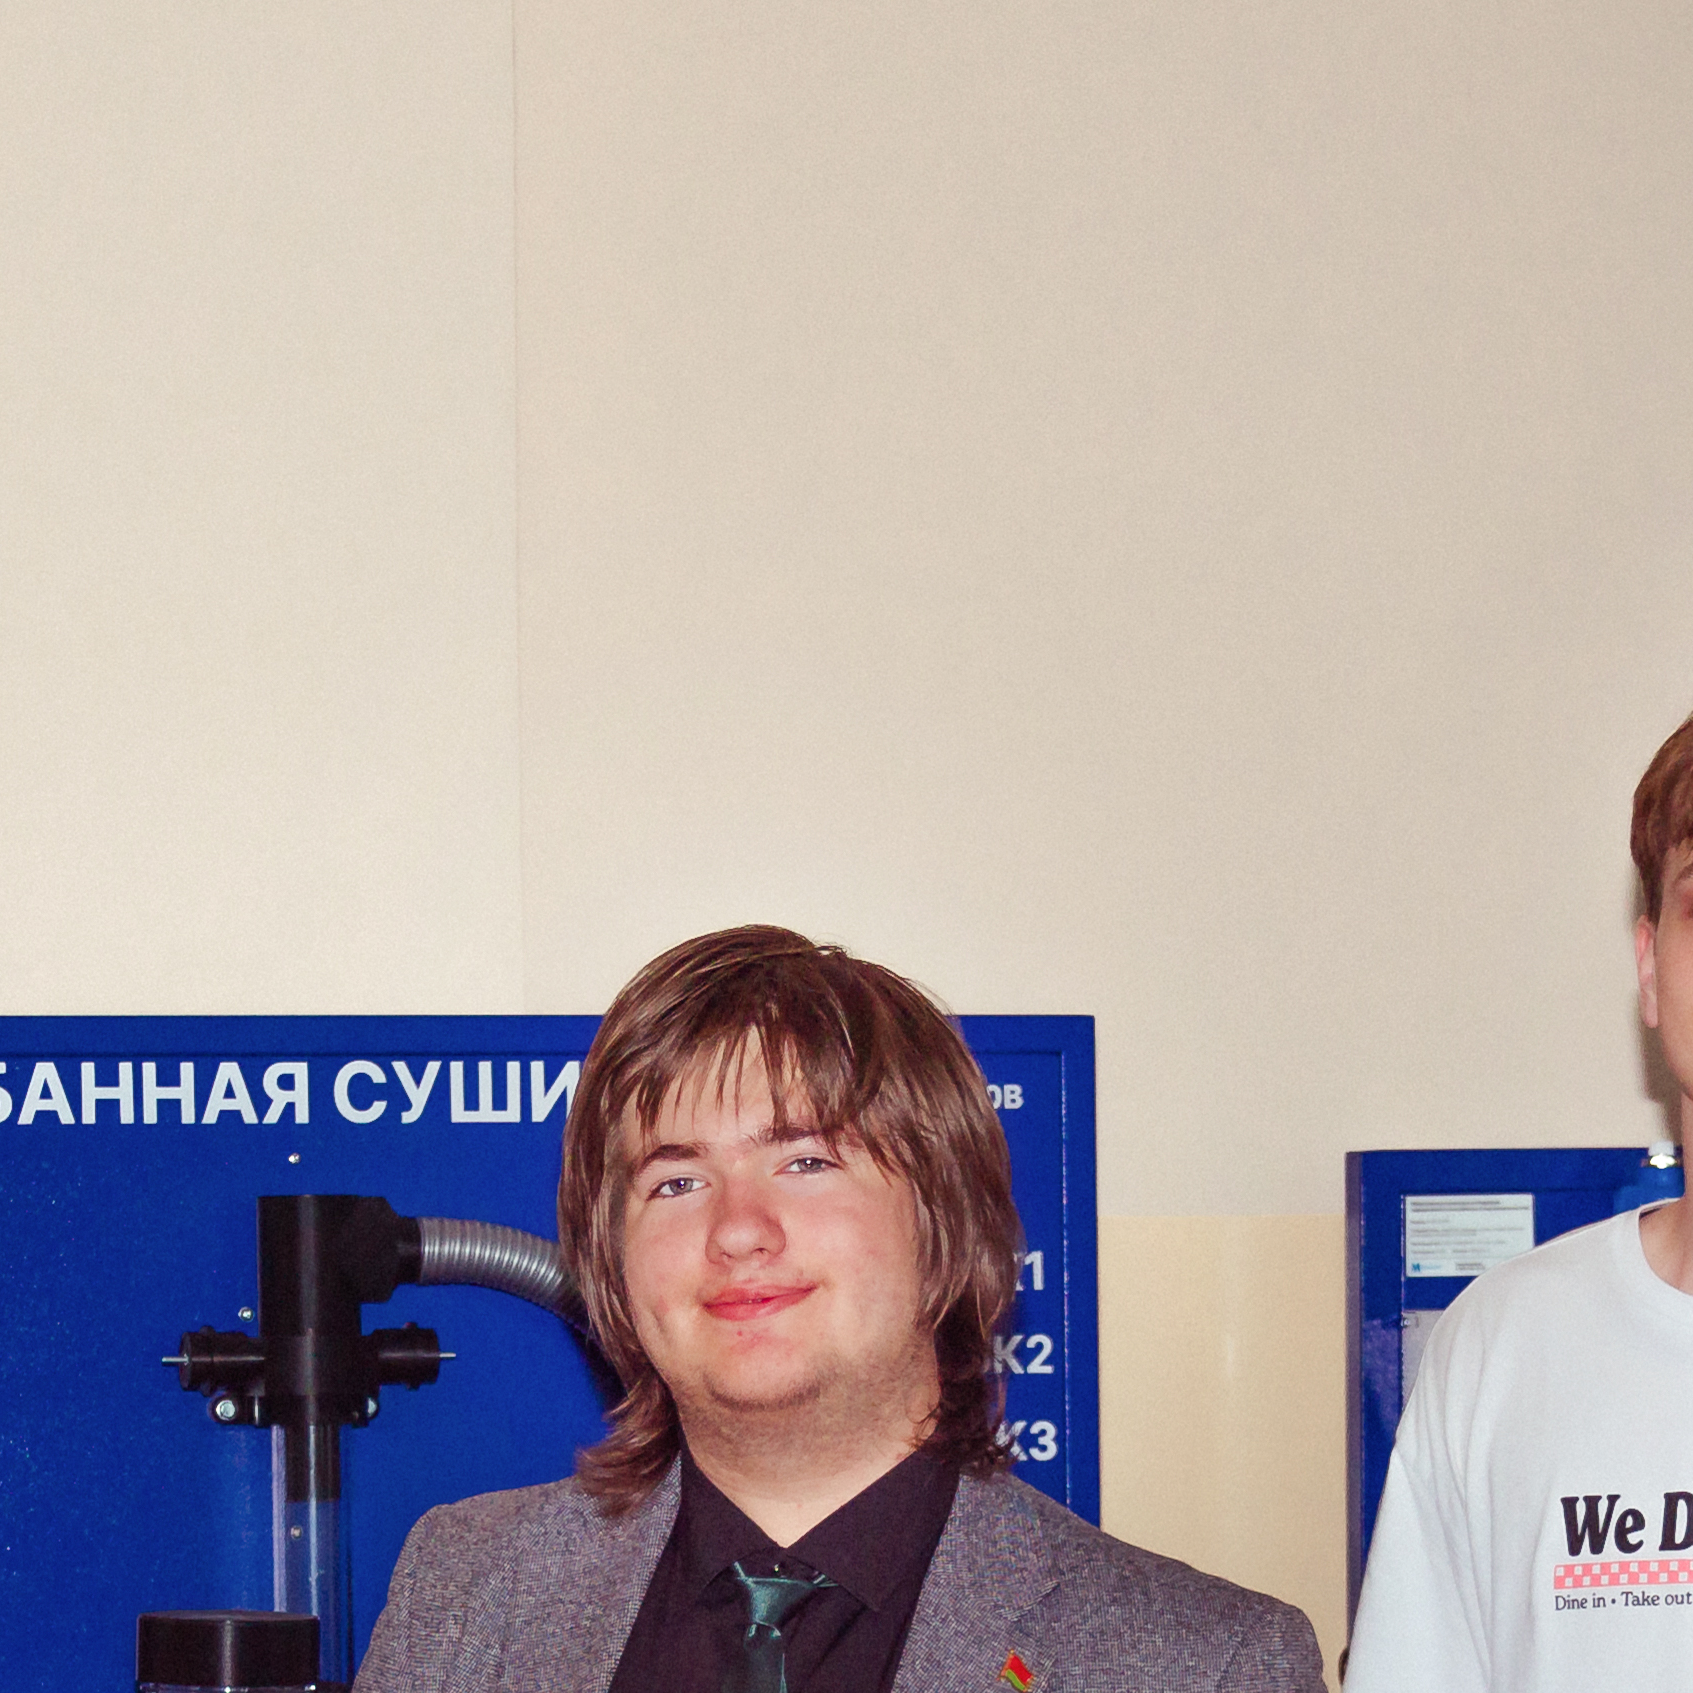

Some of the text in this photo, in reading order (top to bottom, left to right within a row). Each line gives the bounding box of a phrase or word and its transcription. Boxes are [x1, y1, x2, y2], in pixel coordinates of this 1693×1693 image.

[333, 1059, 580, 1123] СУШИ
[1560, 1494, 1646, 1557] We
[1554, 1594, 1588, 1611] Dine
[1592, 1593, 1607, 1608] in
[1620, 1590, 1661, 1607] Take
[1664, 1591, 1693, 1606] out
